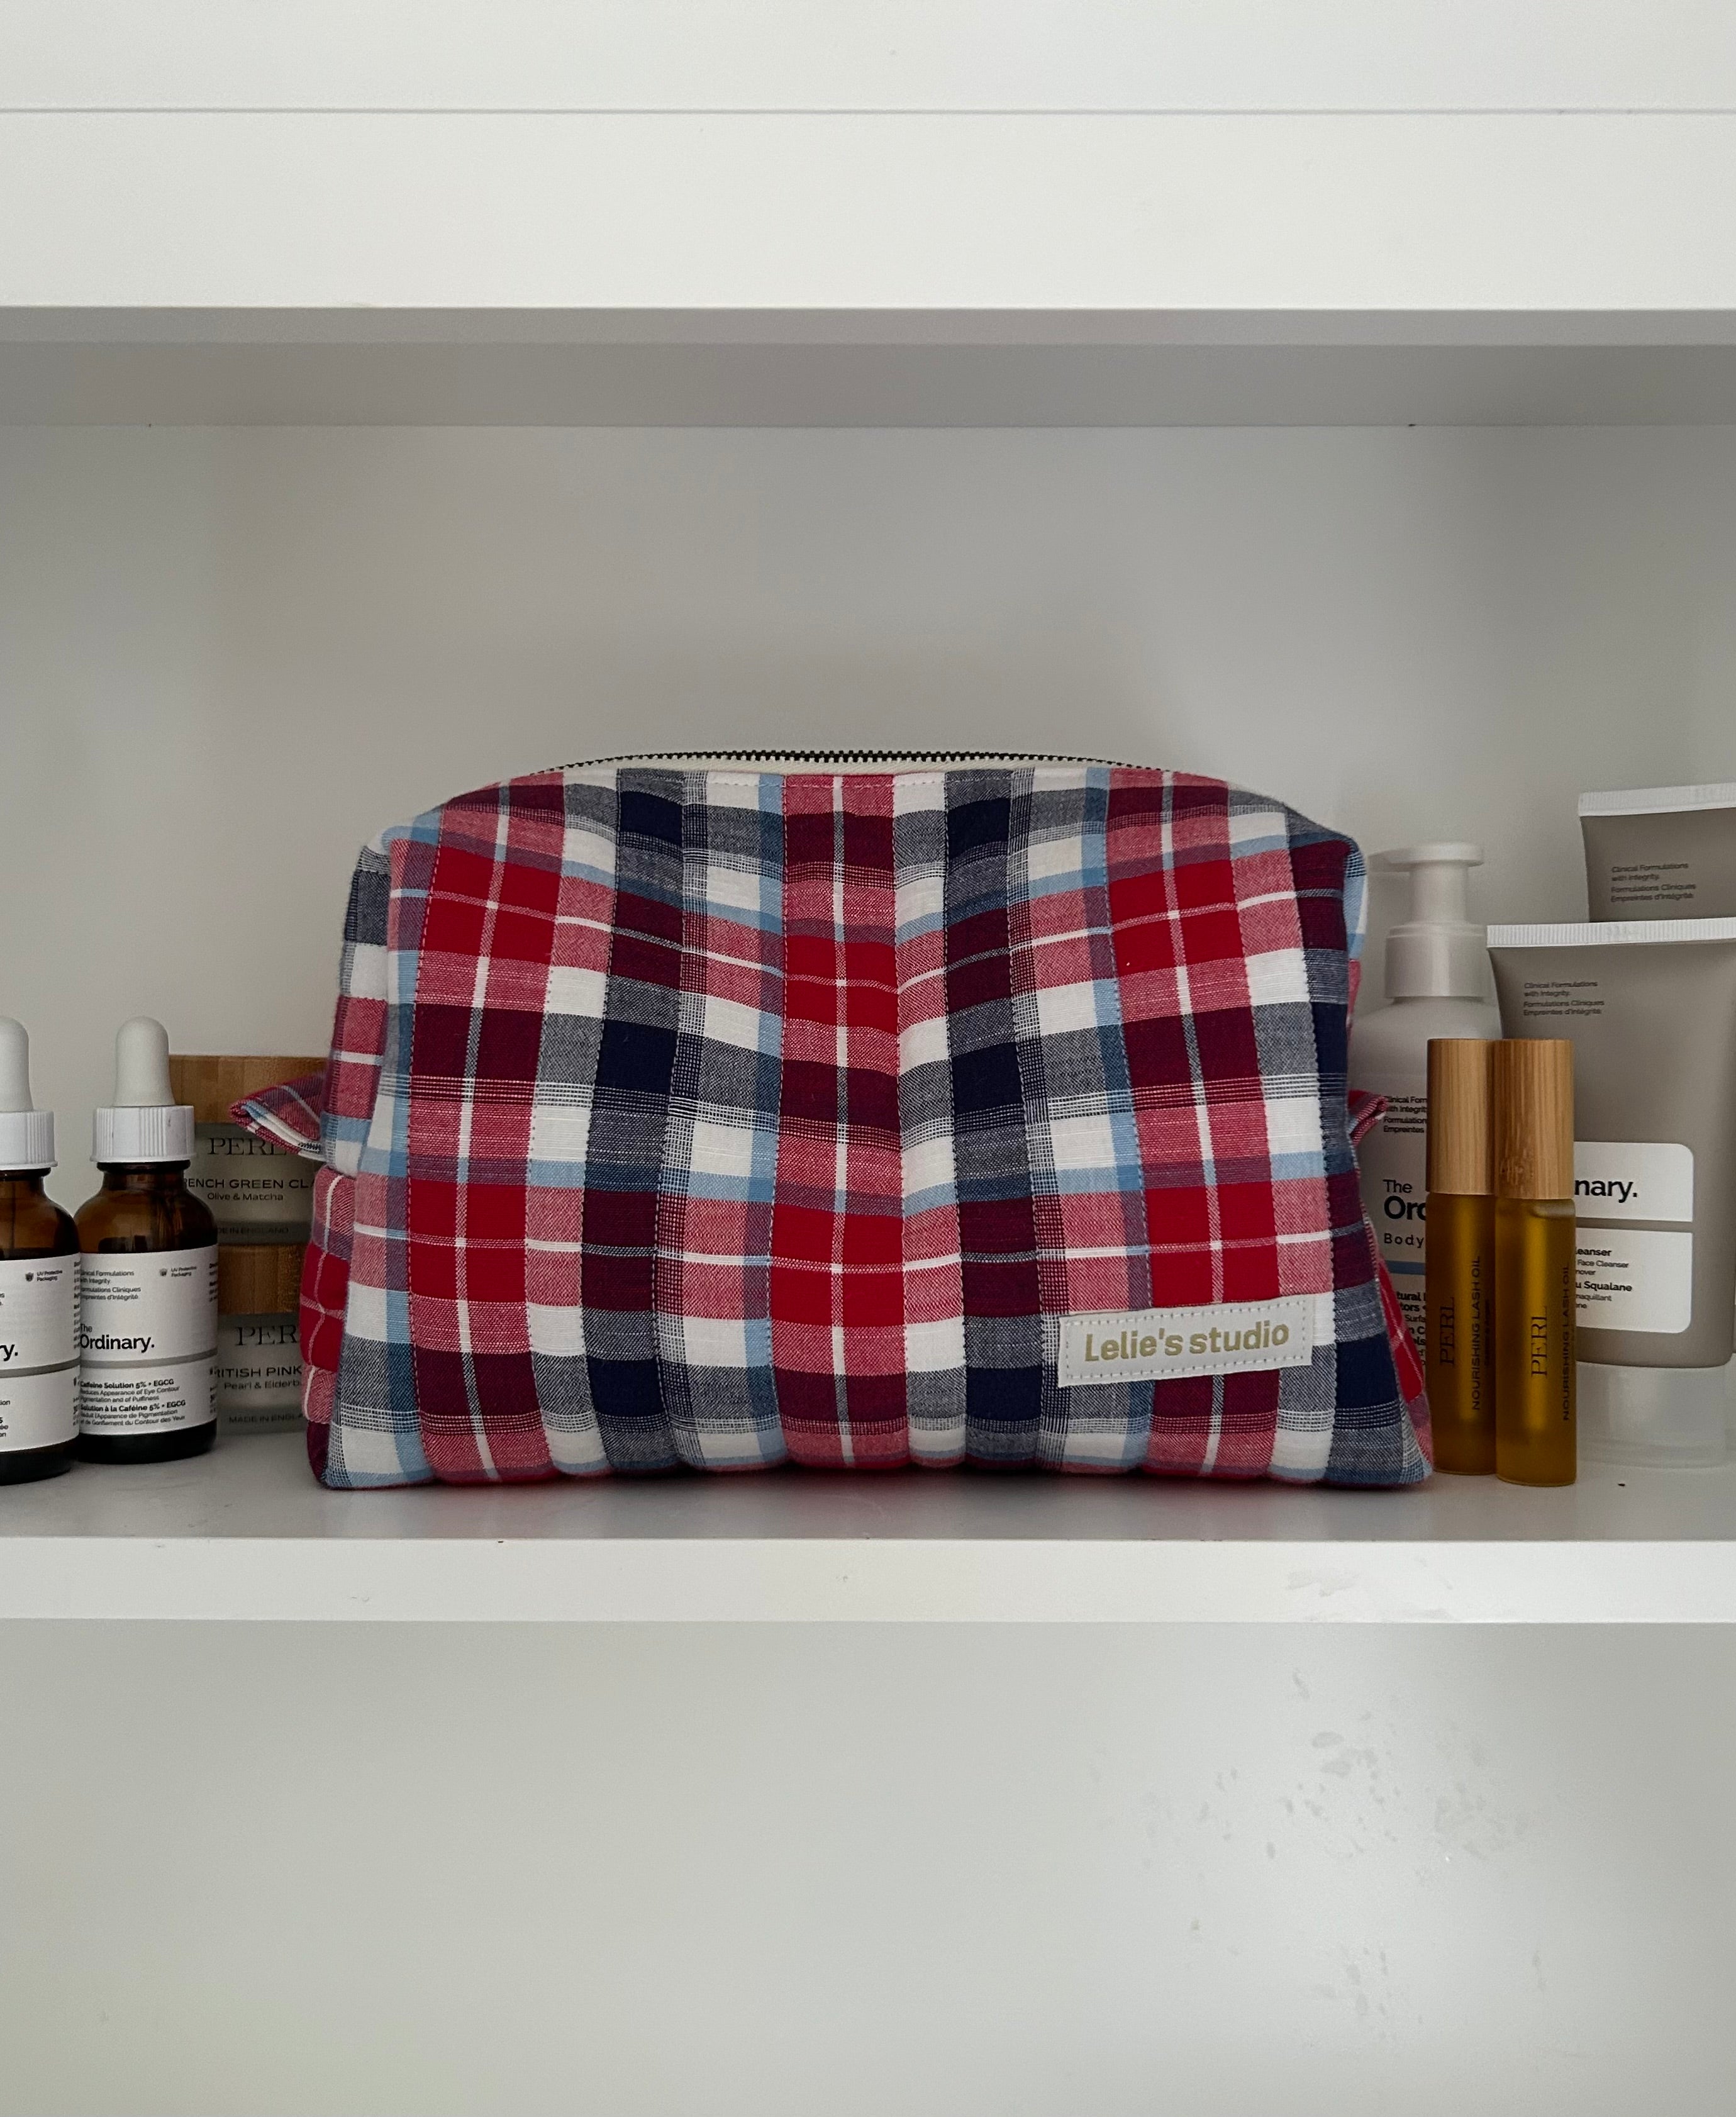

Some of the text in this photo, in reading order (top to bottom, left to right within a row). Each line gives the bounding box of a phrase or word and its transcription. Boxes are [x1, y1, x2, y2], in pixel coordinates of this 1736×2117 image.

[229, 1179, 283, 1189] GREEN
[1383, 1179, 1413, 1193] The
[208, 1192, 230, 1200] Olive
[243, 1193, 283, 1201] Matcha
[1384, 1233, 1424, 1249] Body
[1596, 1260, 1629, 1268] Cleanser
[1584, 1281, 1632, 1292] Squalane
[80, 1323, 92, 1332] The
[1440, 1297, 1455, 1366] PERL
[1472, 1256, 1480, 1410] NOURISHING LASH OIL
[80, 1334, 155, 1353] Ordinary.
[1084, 1320, 1289, 1363] Lelie's studio
[1531, 1305, 1547, 1378] PERL
[267, 1365, 303, 1377] PINK
[104, 1382, 134, 1390] Solution
[154, 1378, 174, 1387] EGCG
[225, 1382, 251, 1390] Pearl
[254, 1382, 262, 1390] &
[144, 1388, 155, 1396] Eye
[119, 1404, 148, 1412] Caféine
[167, 1400, 186, 1409] EGCG
[138, 1409, 177, 1418] Pigmentation
